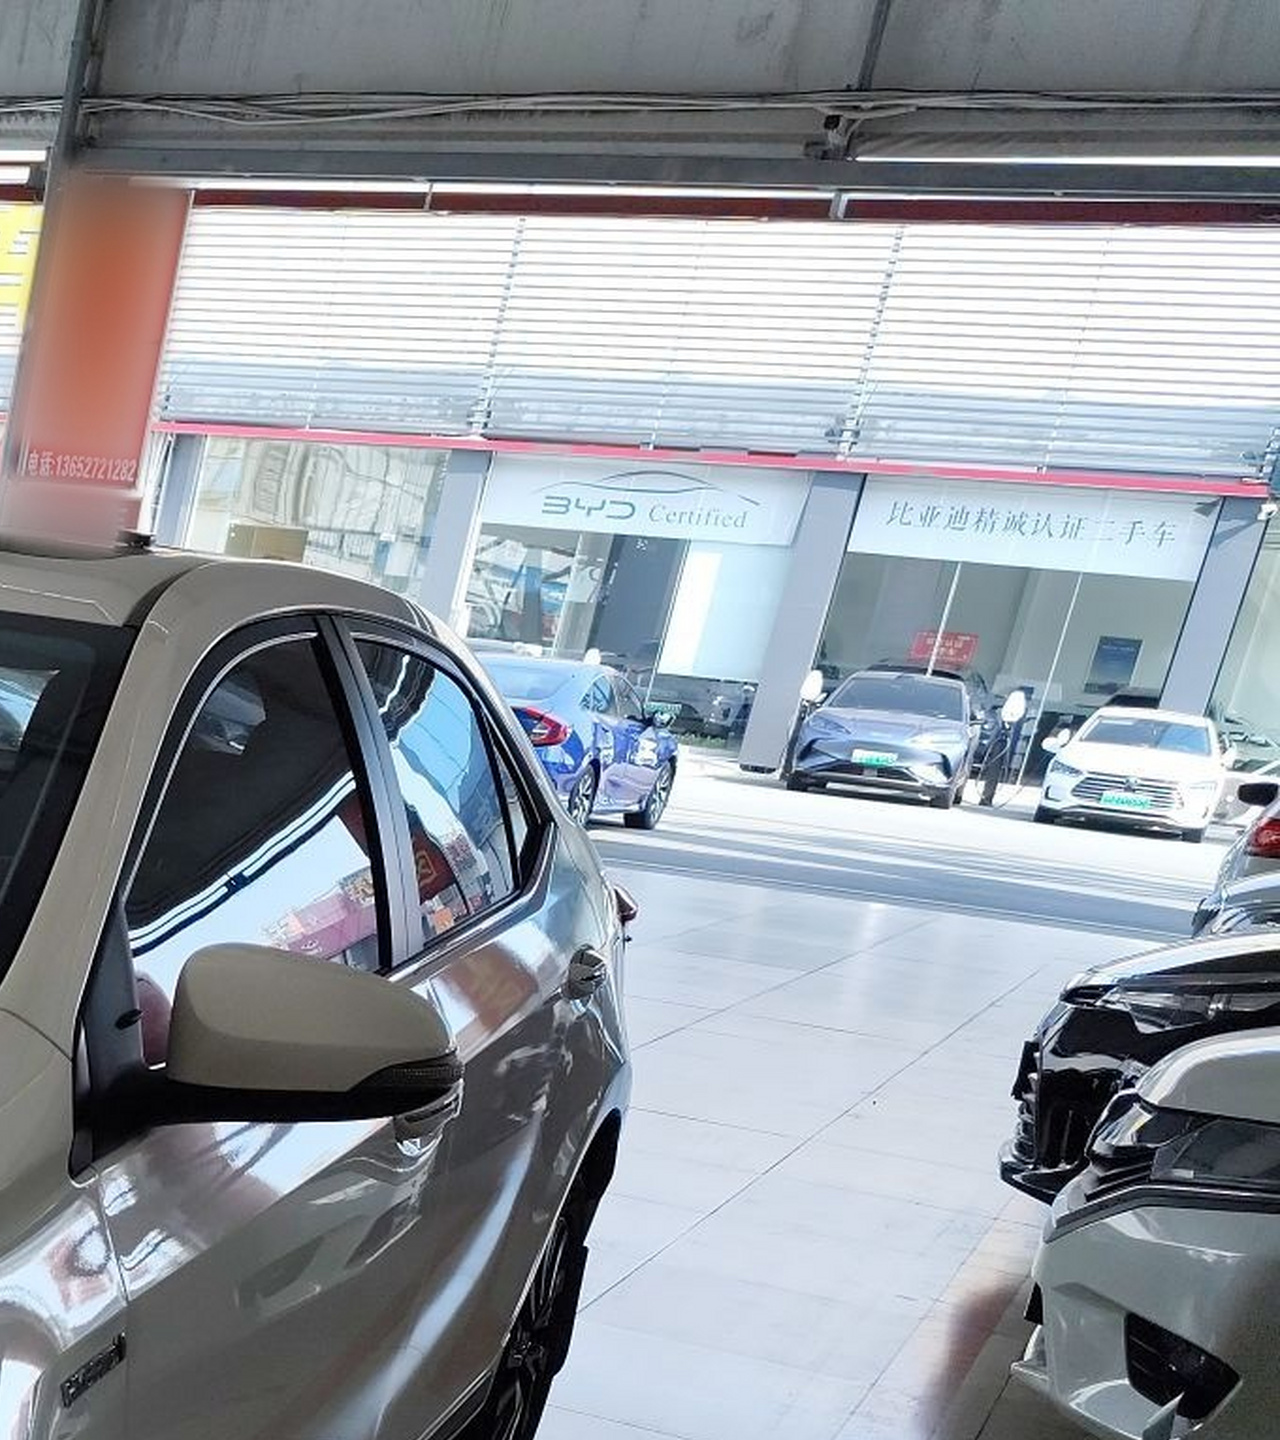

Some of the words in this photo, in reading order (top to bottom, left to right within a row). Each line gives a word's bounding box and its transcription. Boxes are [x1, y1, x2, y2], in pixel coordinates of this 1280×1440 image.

[541, 495, 636, 520] BYD
[648, 504, 749, 529] Certified
[886, 499, 1177, 547] 比亚迪精诚认证二手车
